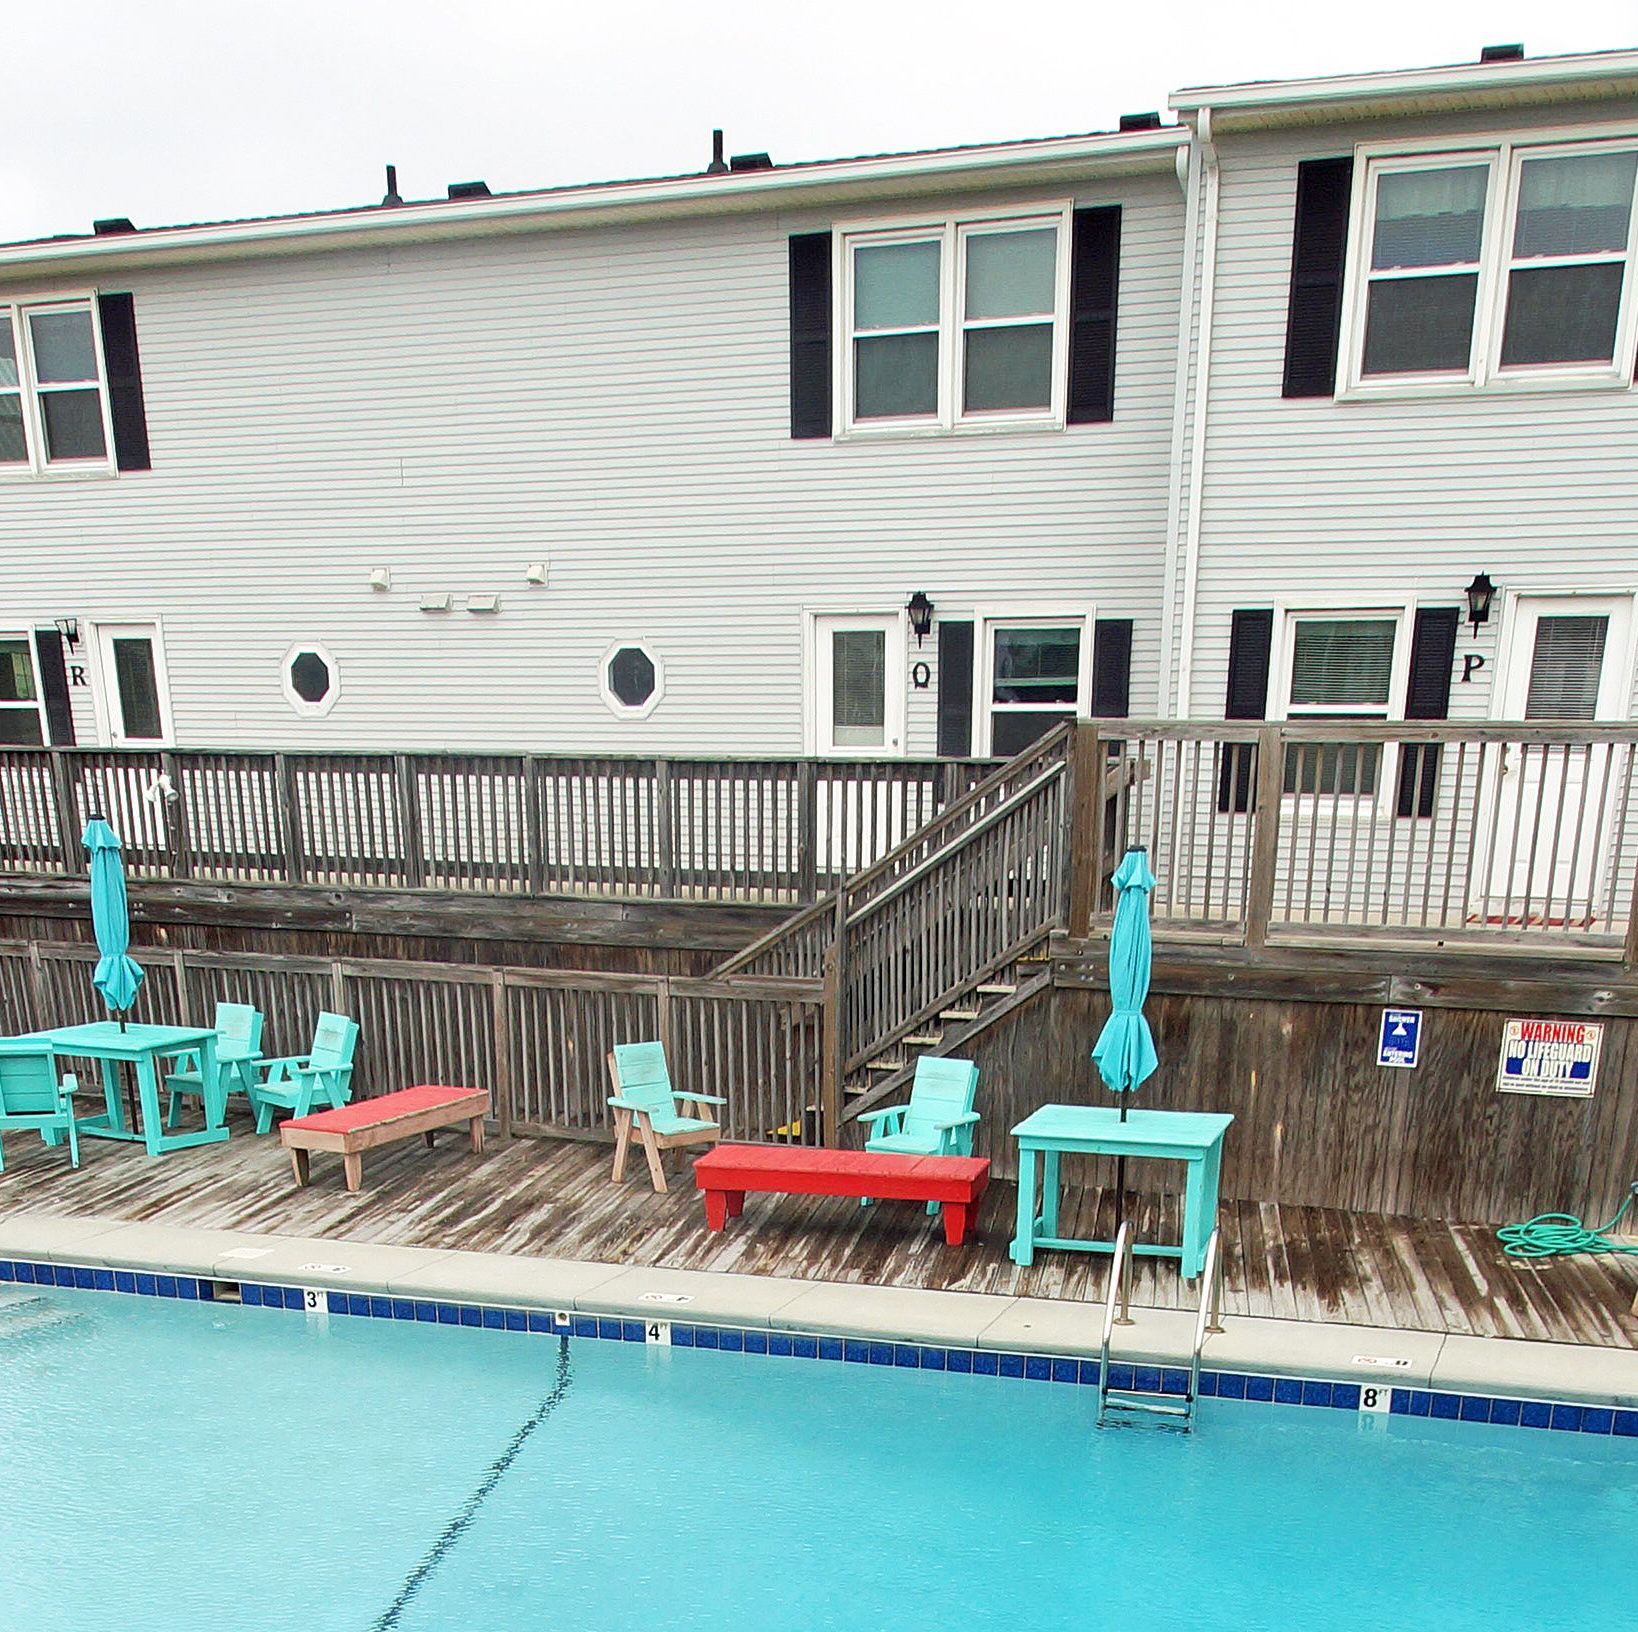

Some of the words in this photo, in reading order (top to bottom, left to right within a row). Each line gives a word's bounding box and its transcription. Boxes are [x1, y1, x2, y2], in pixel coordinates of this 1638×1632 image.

[70, 665, 87, 686] R
[913, 661, 930, 689] Q
[1461, 654, 1485, 683] P
[1520, 1021, 1586, 1044] WARNING
[1508, 1039, 1526, 1059] NO
[1528, 1040, 1592, 1062] LIFEGUARD
[1522, 1058, 1539, 1076] ON
[1541, 1060, 1574, 1079] DUTY
[306, 1291, 317, 1308] 3
[648, 1321, 660, 1341] 4
[1363, 1388, 1378, 1408] 8
